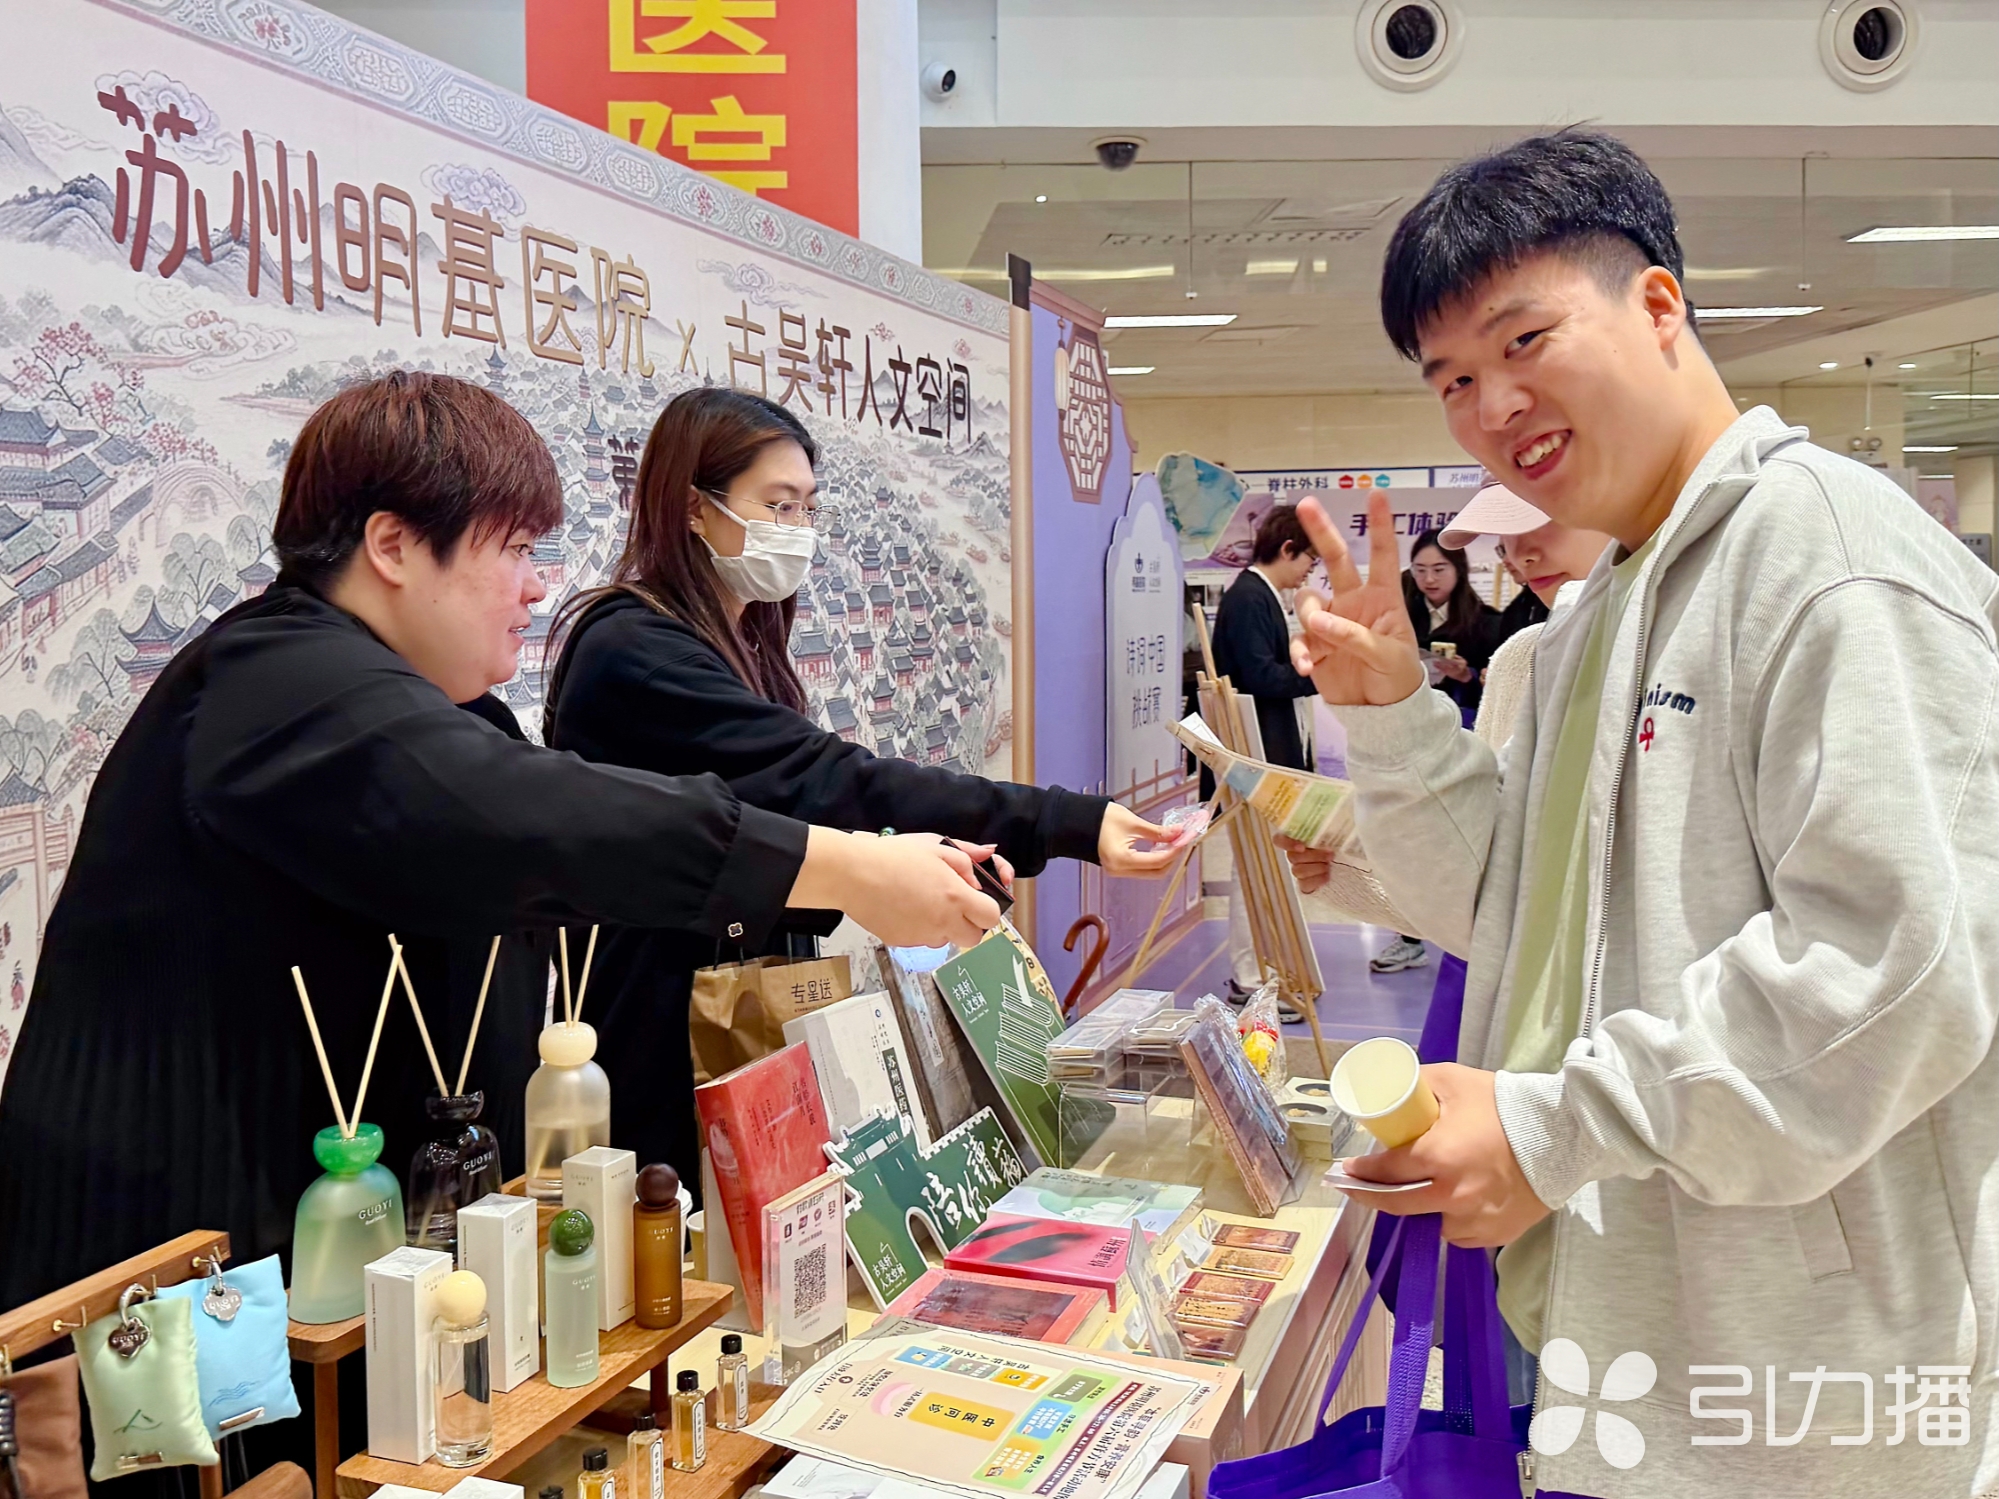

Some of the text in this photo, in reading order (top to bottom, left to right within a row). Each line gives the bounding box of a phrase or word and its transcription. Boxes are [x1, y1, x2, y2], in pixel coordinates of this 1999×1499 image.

[98, 85, 655, 378] 苏州明基医院
[724, 300, 972, 444] 古吴轩人文空间
[1267, 476, 1329, 493] 脊柱外科
[790, 978, 833, 1005] 专星送
[951, 978, 974, 1002] 古吴轩
[960, 991, 988, 1018] 人文空间
[462, 1151, 493, 1172] GUOYI
[358, 1198, 393, 1221] GUOYI
[871, 1254, 893, 1278] 古吴轩
[880, 1262, 908, 1291] 人文空间
[924, 1402, 998, 1428] 中医问诊
